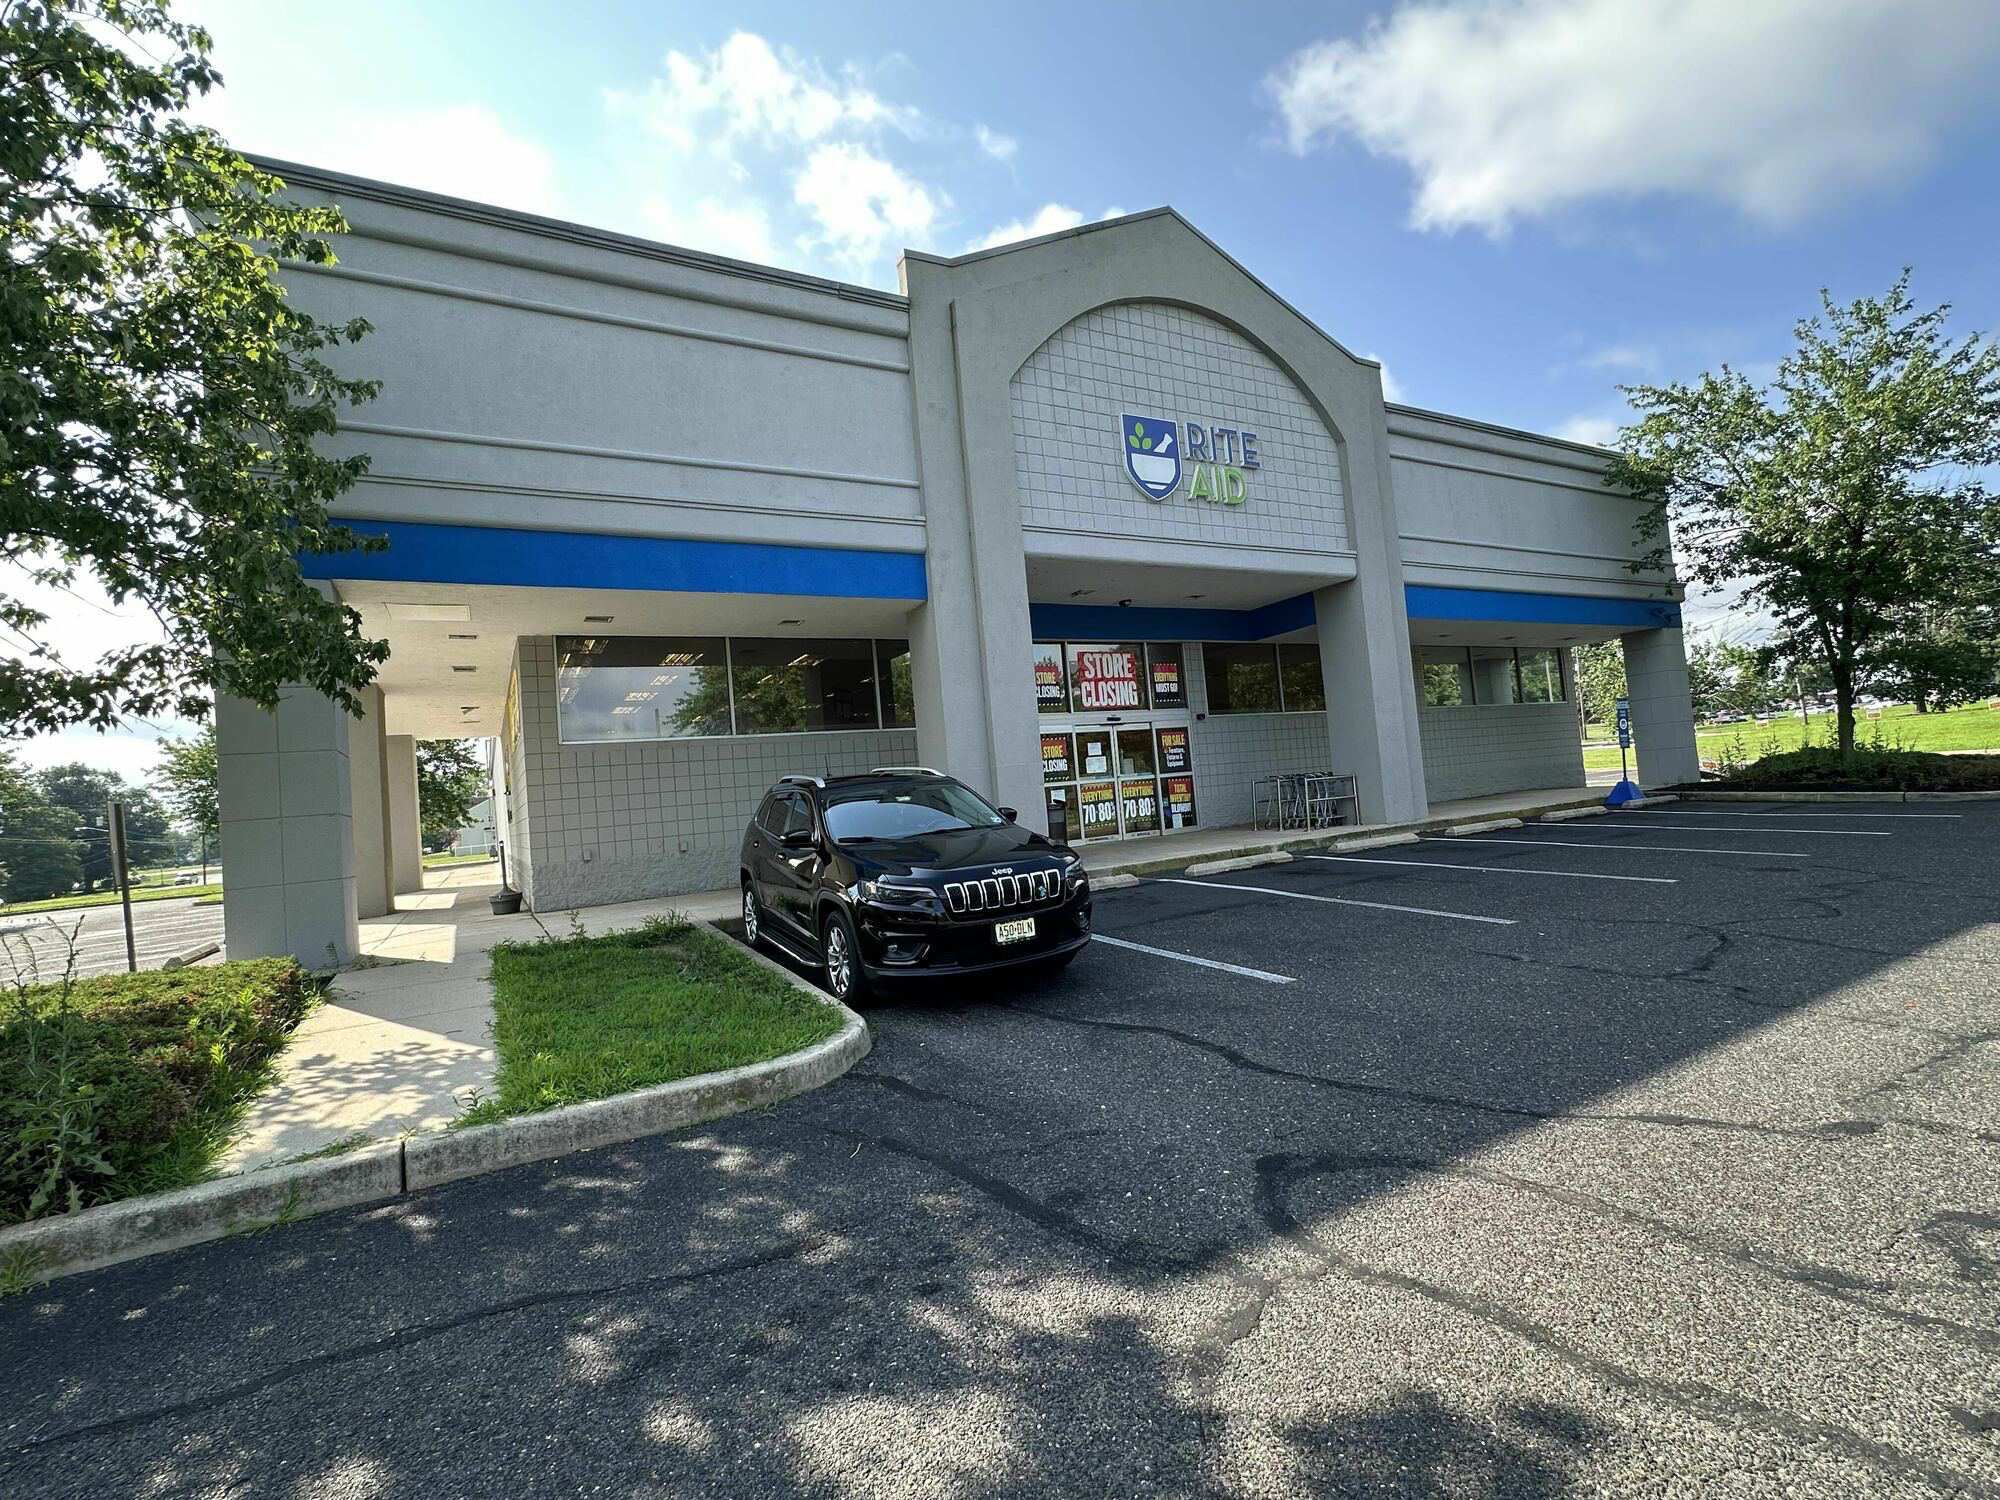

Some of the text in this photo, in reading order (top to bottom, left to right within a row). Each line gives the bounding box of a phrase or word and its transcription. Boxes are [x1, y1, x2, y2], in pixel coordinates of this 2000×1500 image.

[1184, 421, 1262, 469] RITE
[1188, 464, 1247, 505] AID
[1084, 653, 1133, 679] STORE
[1036, 671, 1057, 684] STORE
[1081, 680, 1138, 707] CLOSING
[1162, 734, 1185, 746] FOR SALE
[1043, 745, 1064, 758] STORE
[991, 867, 1013, 875] Jeep
